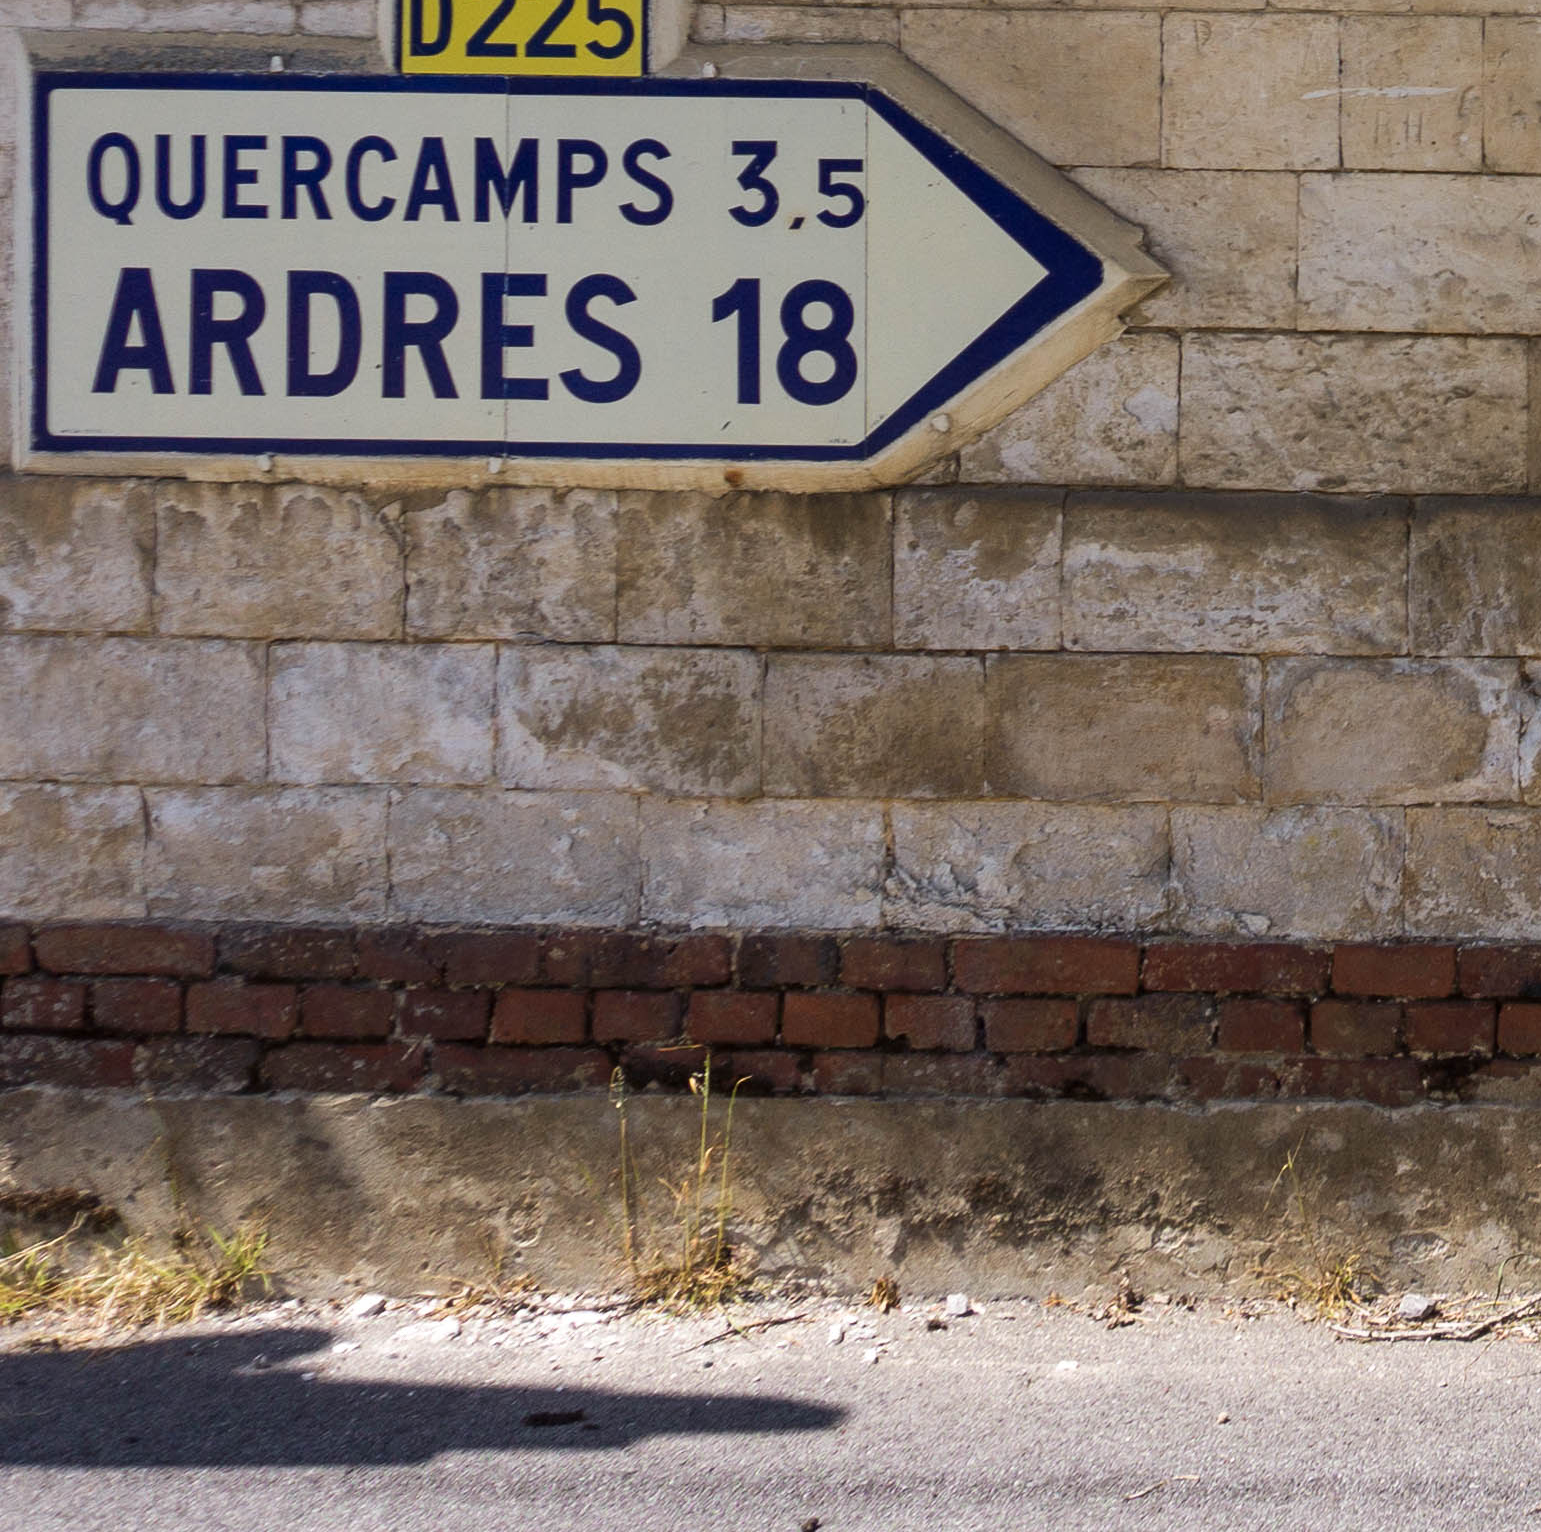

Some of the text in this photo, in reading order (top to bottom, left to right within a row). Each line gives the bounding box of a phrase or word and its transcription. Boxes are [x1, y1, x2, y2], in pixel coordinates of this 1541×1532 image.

[87, 131, 866, 232] QUERCAMPS 3,5
[91, 266, 859, 407] ARDRES 18
